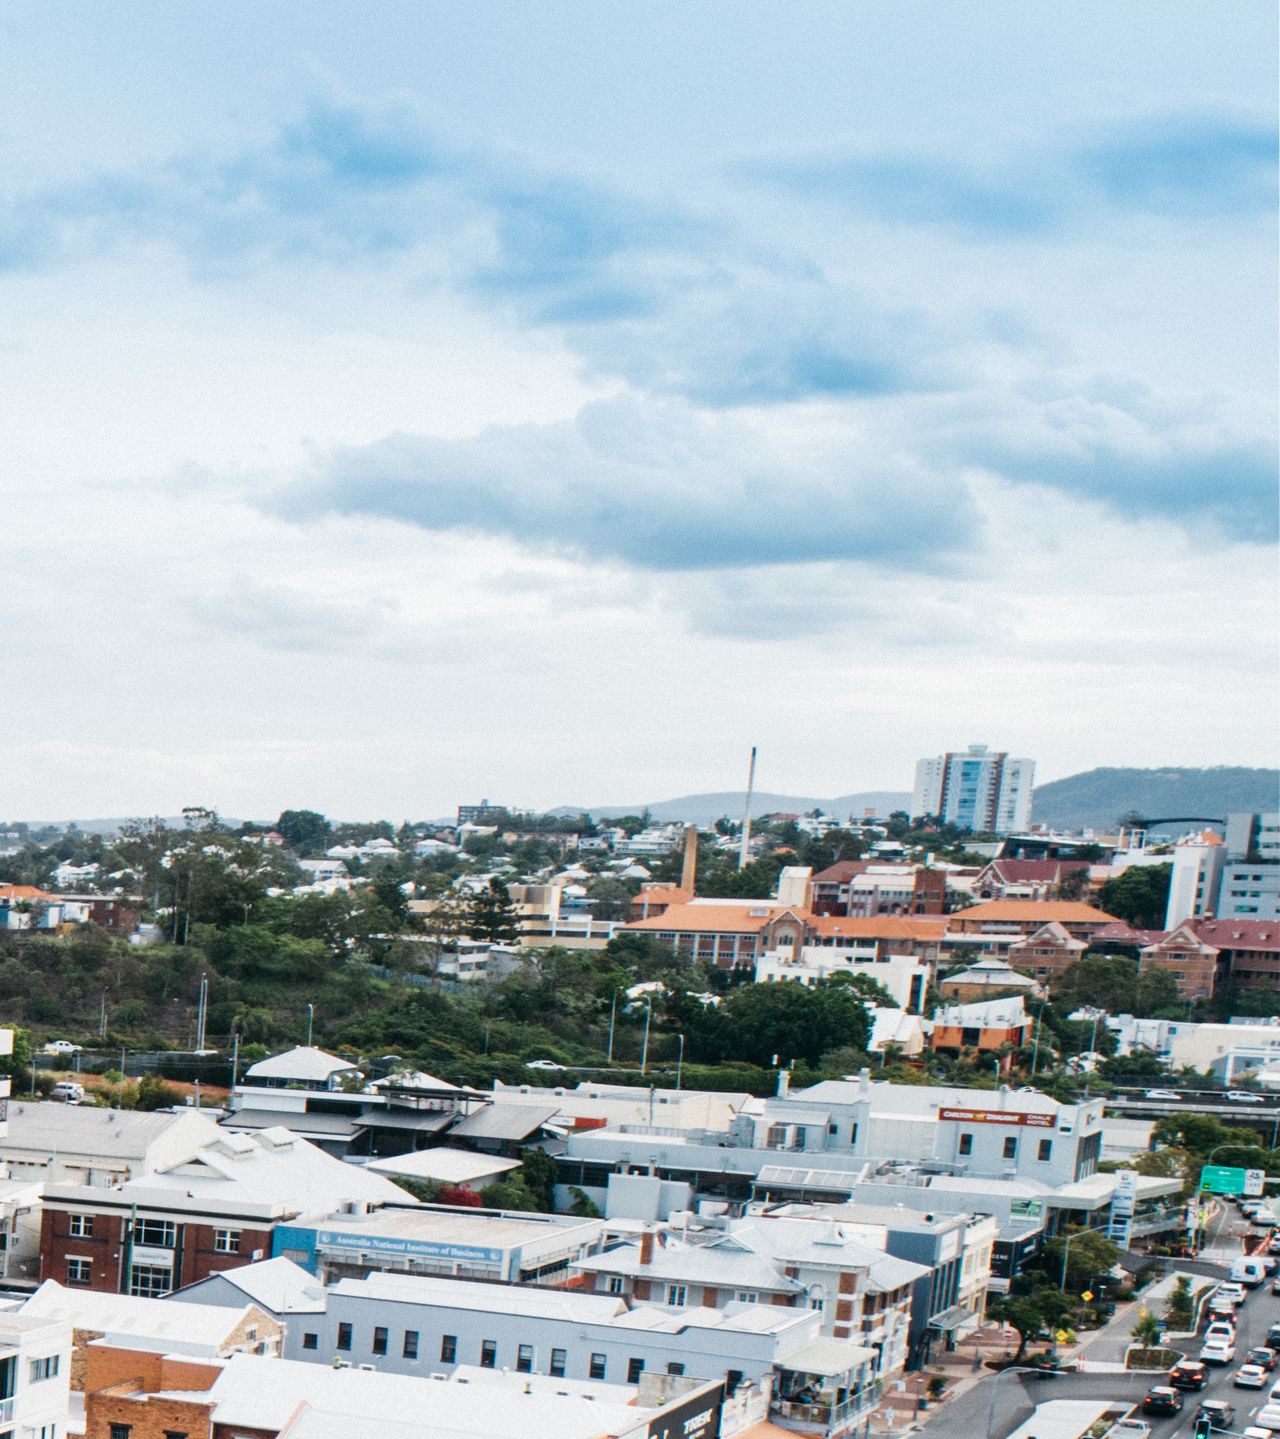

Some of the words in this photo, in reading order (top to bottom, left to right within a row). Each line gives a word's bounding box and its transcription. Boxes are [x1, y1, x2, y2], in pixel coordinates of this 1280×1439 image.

[336, 1236, 371, 1247] Australia
[372, 1239, 405, 1250] National
[406, 1243, 439, 1253] Institute
[441, 1246, 449, 1254] of
[450, 1247, 485, 1259] Business
